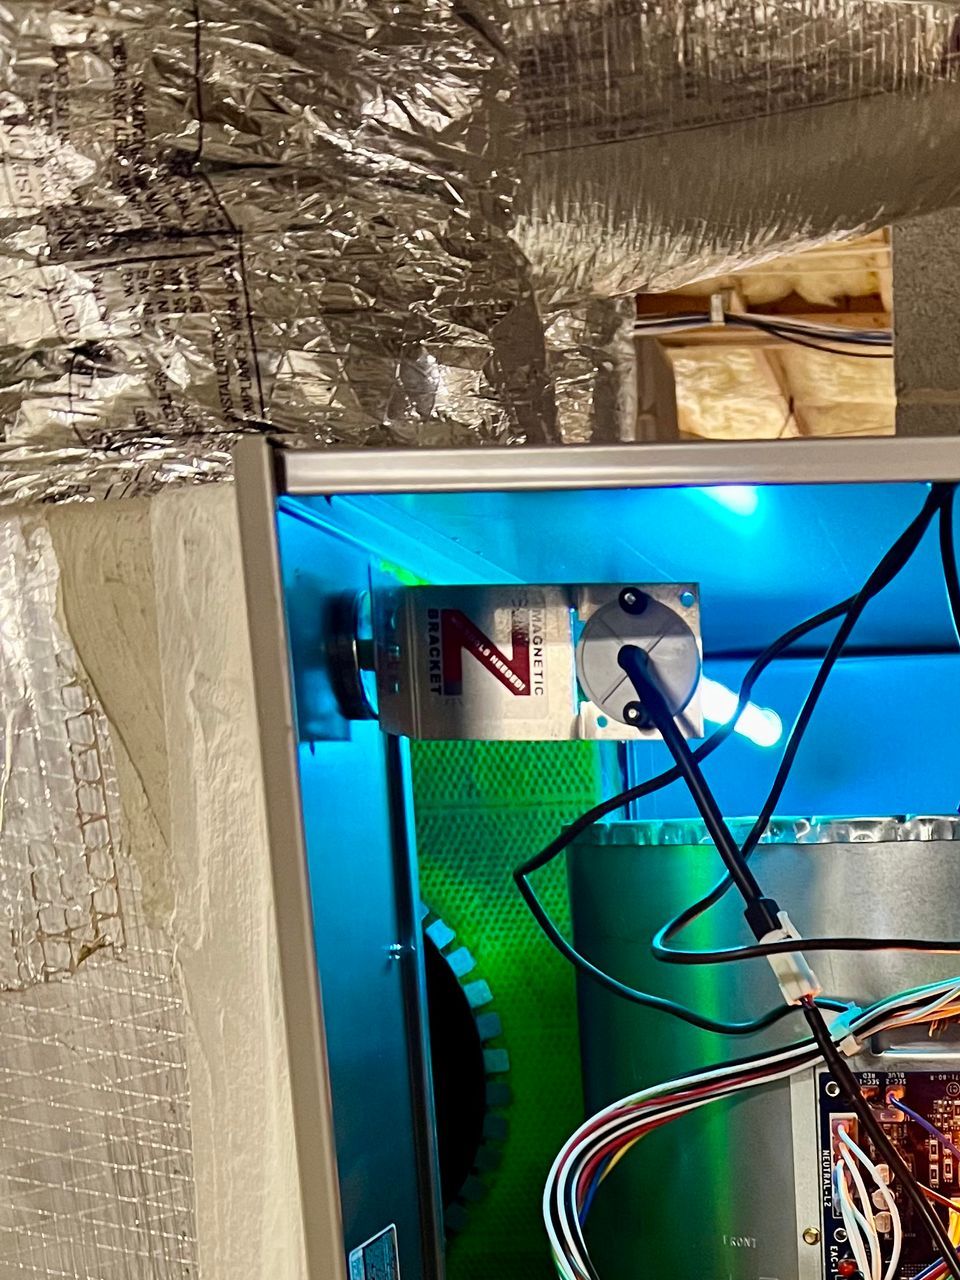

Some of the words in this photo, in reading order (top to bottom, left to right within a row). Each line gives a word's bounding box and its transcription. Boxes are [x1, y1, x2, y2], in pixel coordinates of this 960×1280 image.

[427, 608, 442, 696] BRACKET
[531, 609, 544, 696] MAGNETIC
[822, 1150, 832, 1207] NEUTRAL-L2
[829, 1245, 838, 1273] EAC-1
